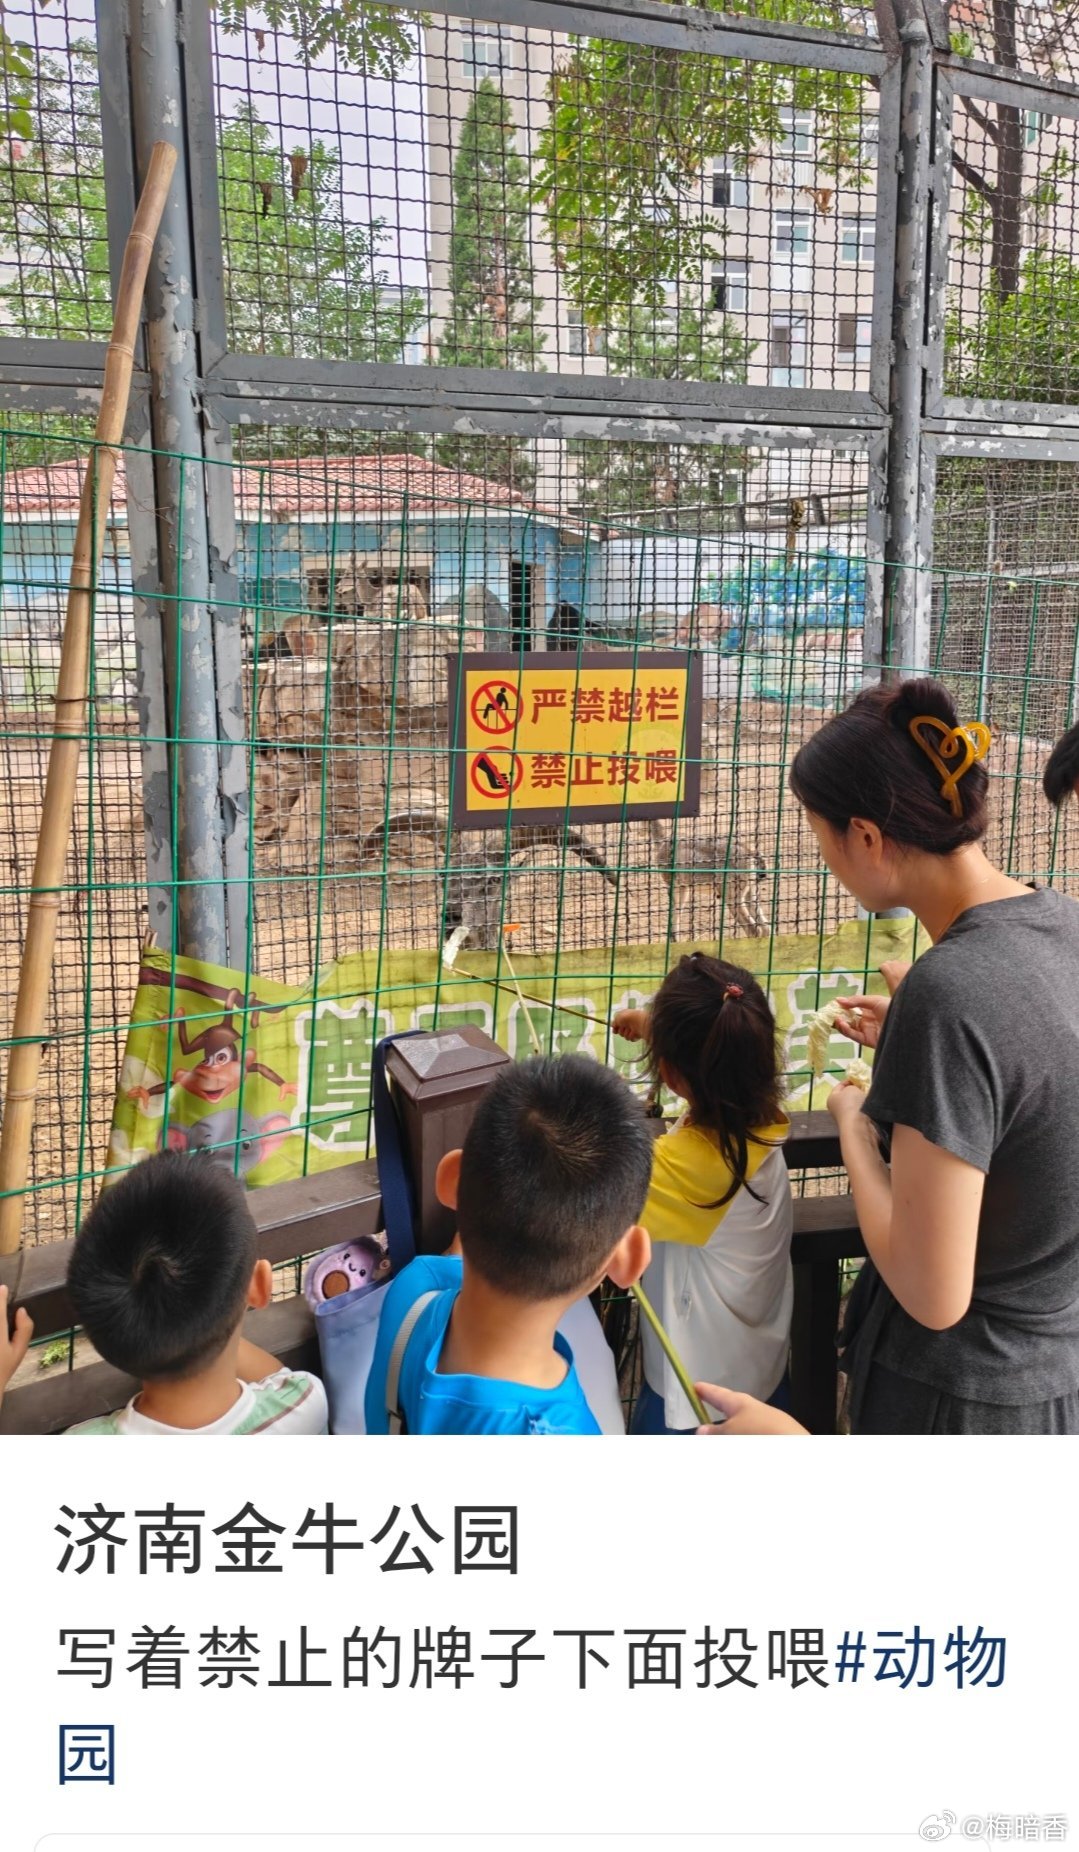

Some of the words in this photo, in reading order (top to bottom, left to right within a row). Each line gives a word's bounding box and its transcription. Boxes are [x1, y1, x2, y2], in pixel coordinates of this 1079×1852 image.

[531, 686, 679, 724] 严禁越栏
[531, 750, 678, 788] 禁止投喂
